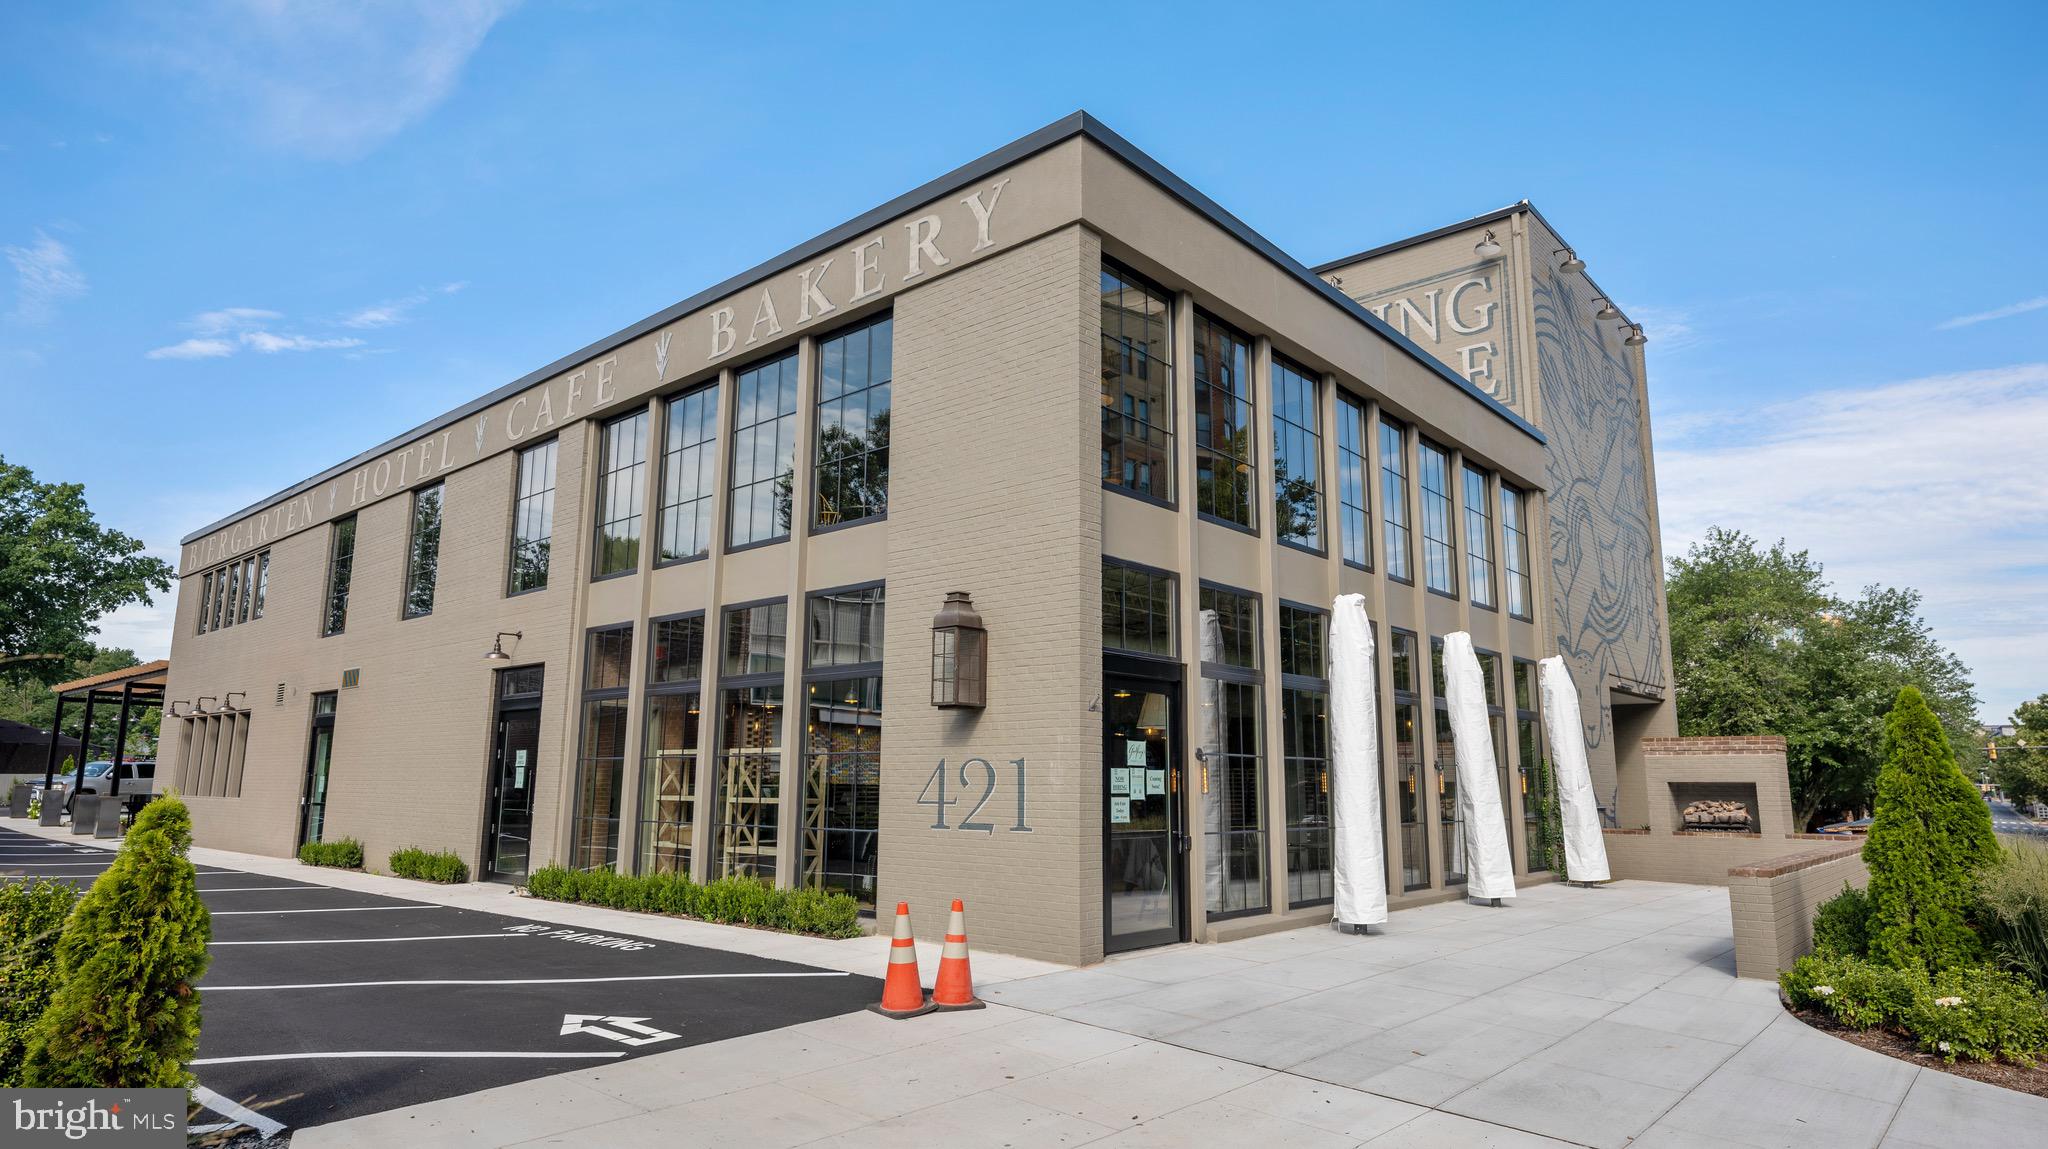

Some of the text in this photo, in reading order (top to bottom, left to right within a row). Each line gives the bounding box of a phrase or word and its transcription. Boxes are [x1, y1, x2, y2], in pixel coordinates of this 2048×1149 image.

[188, 178, 1011, 571] BIERGARTEN HOTEL CAFE BAKERY
[916, 756, 1034, 836] 421
[502, 924, 656, 951] NO PARKING
